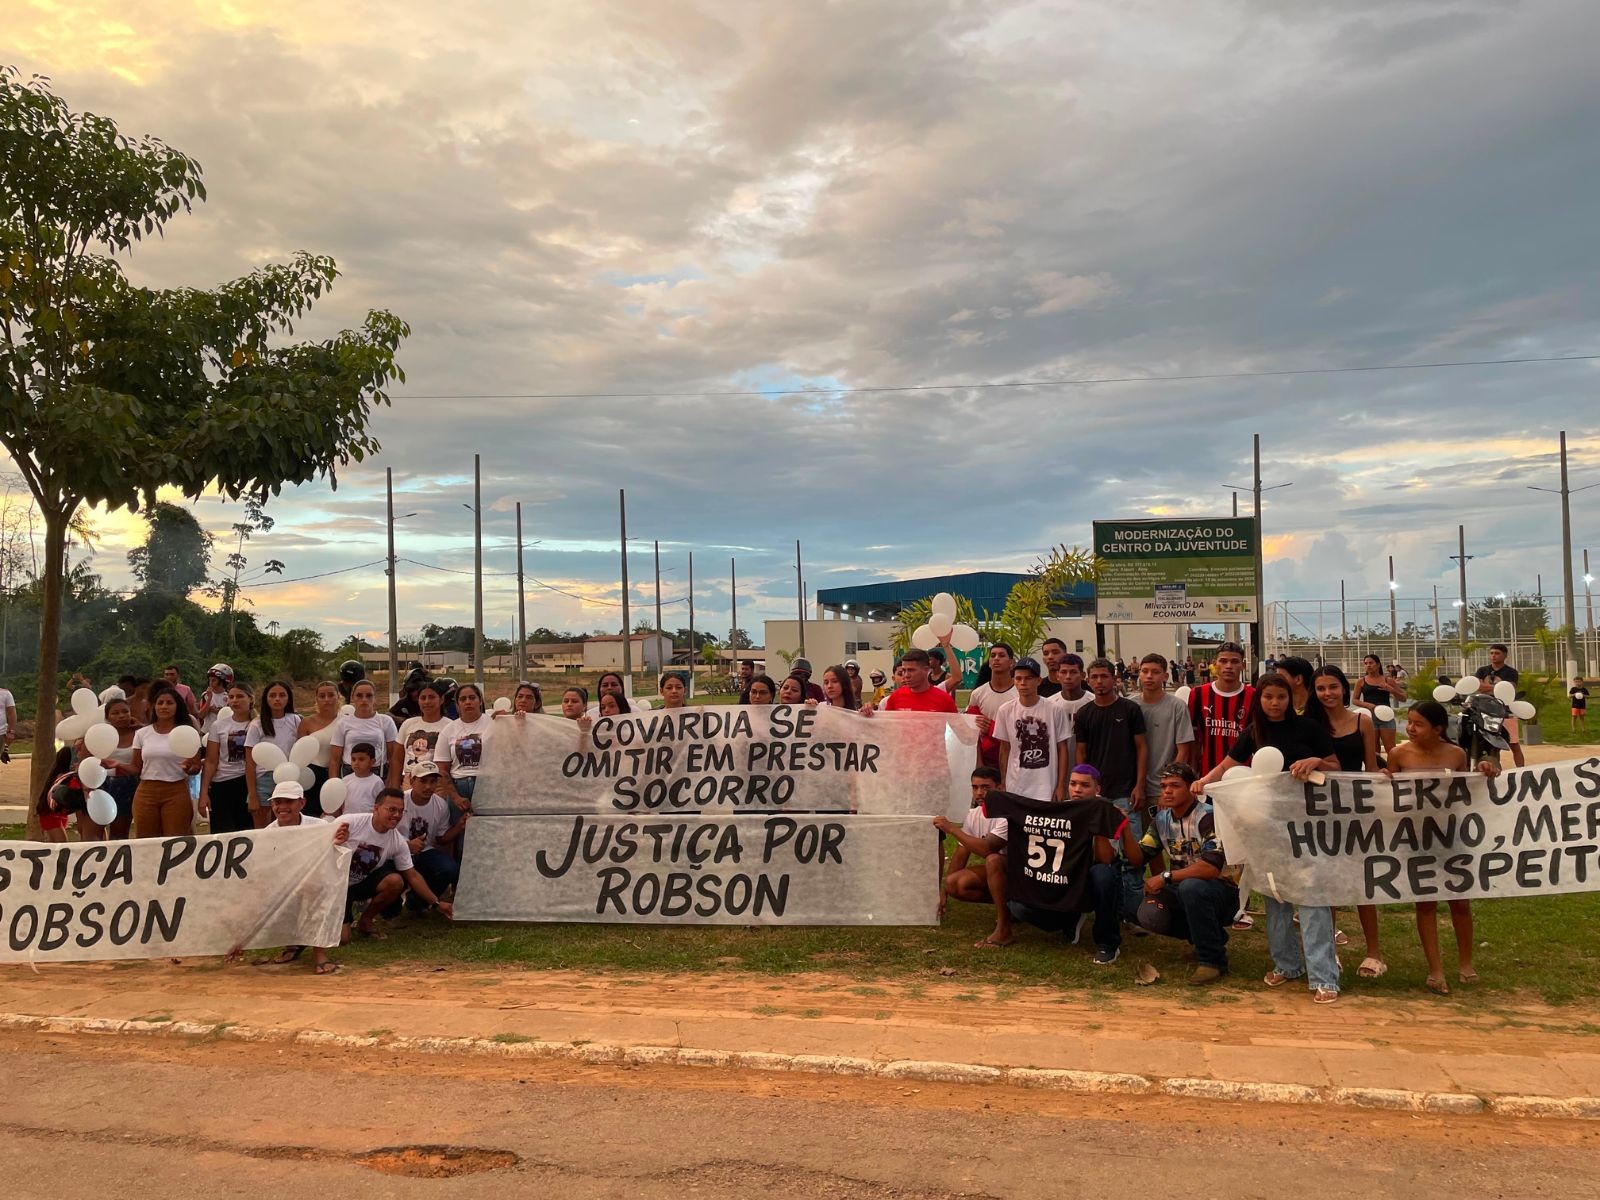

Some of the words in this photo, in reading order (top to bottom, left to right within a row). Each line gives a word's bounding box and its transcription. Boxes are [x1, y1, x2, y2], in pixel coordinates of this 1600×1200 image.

[1102, 542, 1151, 553] CENTRO
[1155, 541, 1172, 552] DA
[1175, 540, 1248, 551] JUVENTUDE
[1114, 527, 1212, 541] MODERNIZAÇÃO
[1215, 527, 1234, 538] DO
[1152, 610, 1196, 618] ECONOMIA
[1193, 601, 1204, 609] DA
[592, 710, 752, 750] COVARDIA
[769, 704, 818, 739] SE
[1210, 727, 1221, 736] FLY
[562, 745, 673, 778] OMITIR
[687, 743, 736, 773] EM
[747, 741, 881, 775] PRESTAR
[1022, 749, 1043, 762] RD
[612, 774, 795, 810] SOCORRO
[1304, 779, 1375, 816] ELE
[1392, 775, 1472, 812] ERA
[1486, 768, 1562, 806] UM
[1023, 826, 1041, 835] QUEM
[1042, 828, 1051, 837] TE
[1053, 830, 1072, 839] COME
[1025, 814, 1072, 830] RESPEITA
[1287, 812, 1505, 859] HUMANO,
[157, 836, 254, 885] POR
[535, 815, 743, 878] JUSTIÇA
[763, 817, 846, 865] POR
[1027, 834, 1065, 872] 57
[1364, 845, 1600, 899] RESPEIT
[596, 866, 790, 917] ROBSON
[0, 896, 186, 952] OBSON
